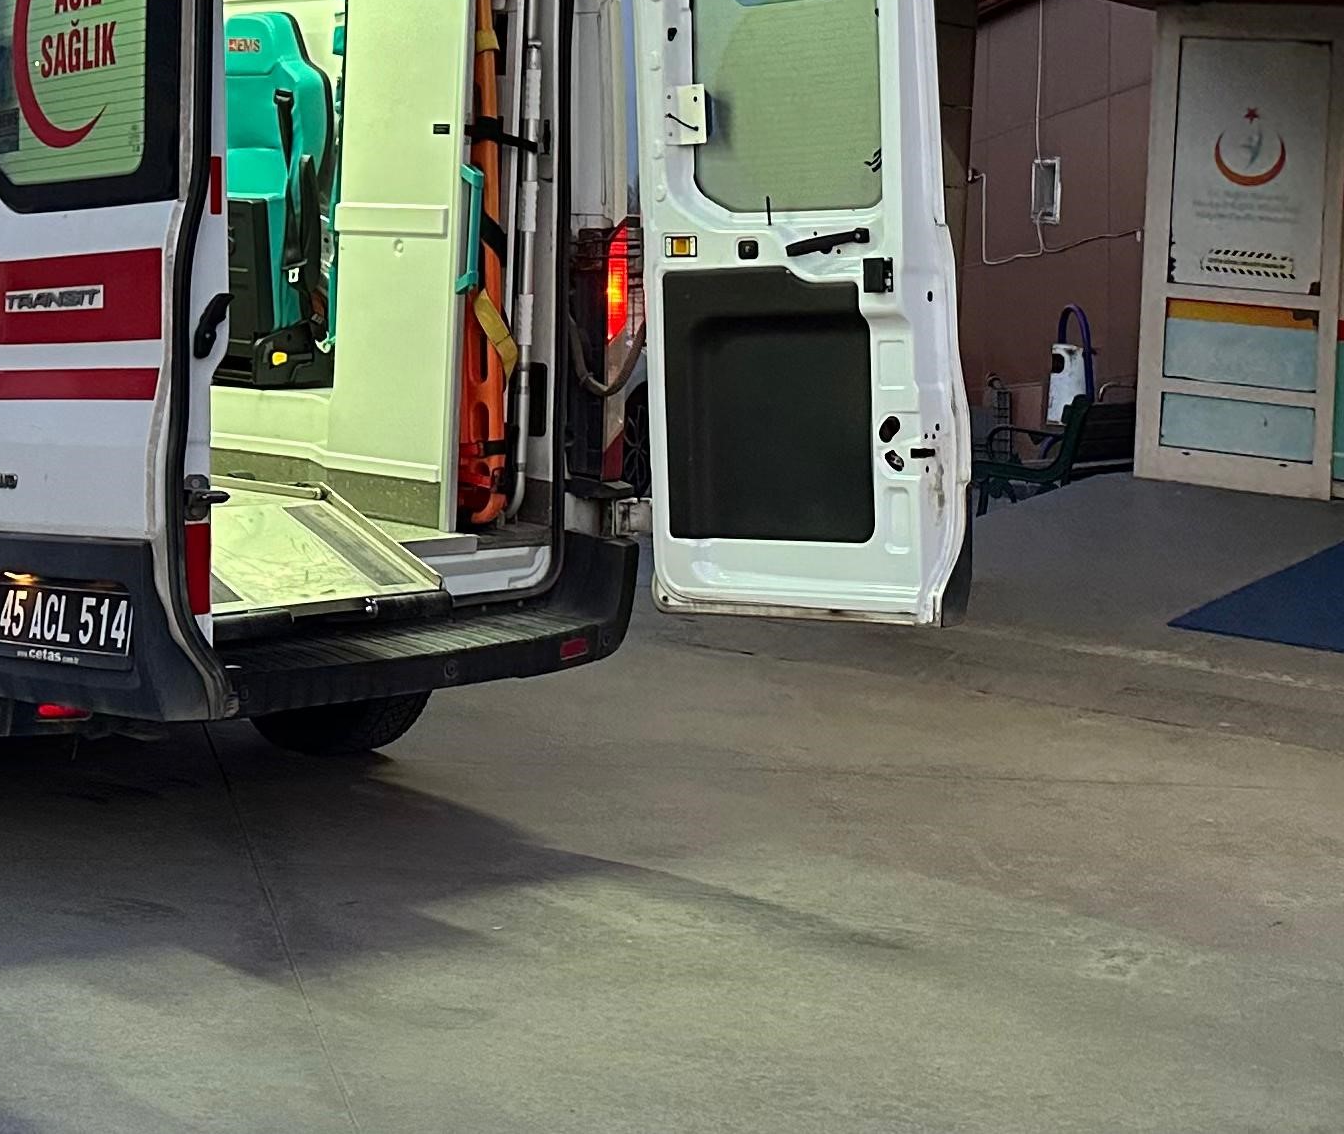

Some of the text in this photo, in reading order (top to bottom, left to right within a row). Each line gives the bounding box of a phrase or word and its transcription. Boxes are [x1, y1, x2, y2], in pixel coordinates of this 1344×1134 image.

[40, 19, 116, 78] SAĞLIK
[6, 288, 101, 310] TRANSIT
[0, 589, 128, 648] 45 ACL 514
